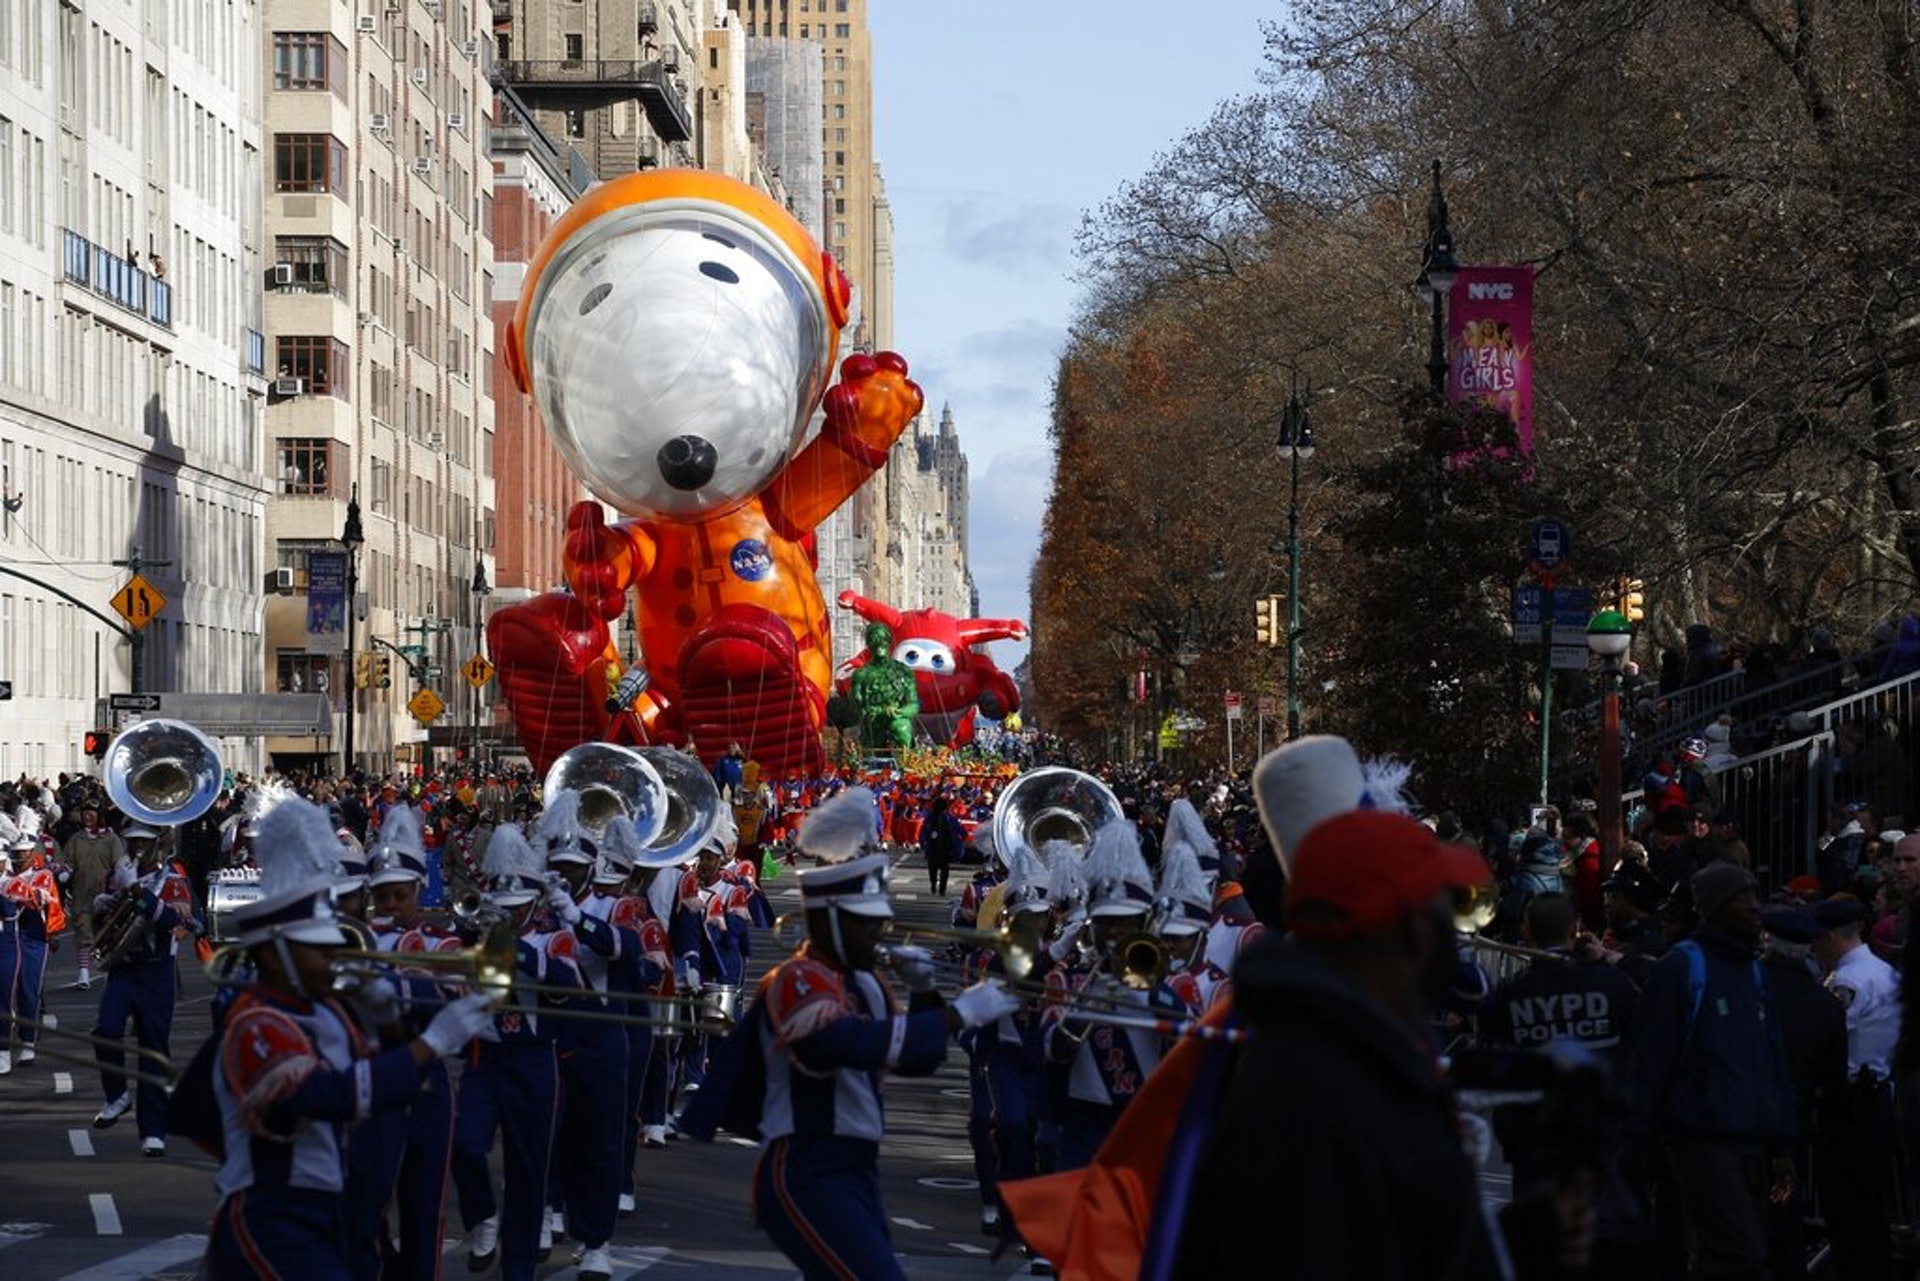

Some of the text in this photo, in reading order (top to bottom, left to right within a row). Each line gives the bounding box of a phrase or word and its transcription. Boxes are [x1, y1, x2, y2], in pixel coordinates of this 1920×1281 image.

[1468, 283, 1514, 300] NYC
[1462, 347, 1514, 368] MEAN
[1460, 367, 1514, 391] GIRLS
[733, 554, 770, 571] NASA
[1509, 992, 1609, 1027] NYPD
[1513, 1019, 1610, 1044] POLICE
